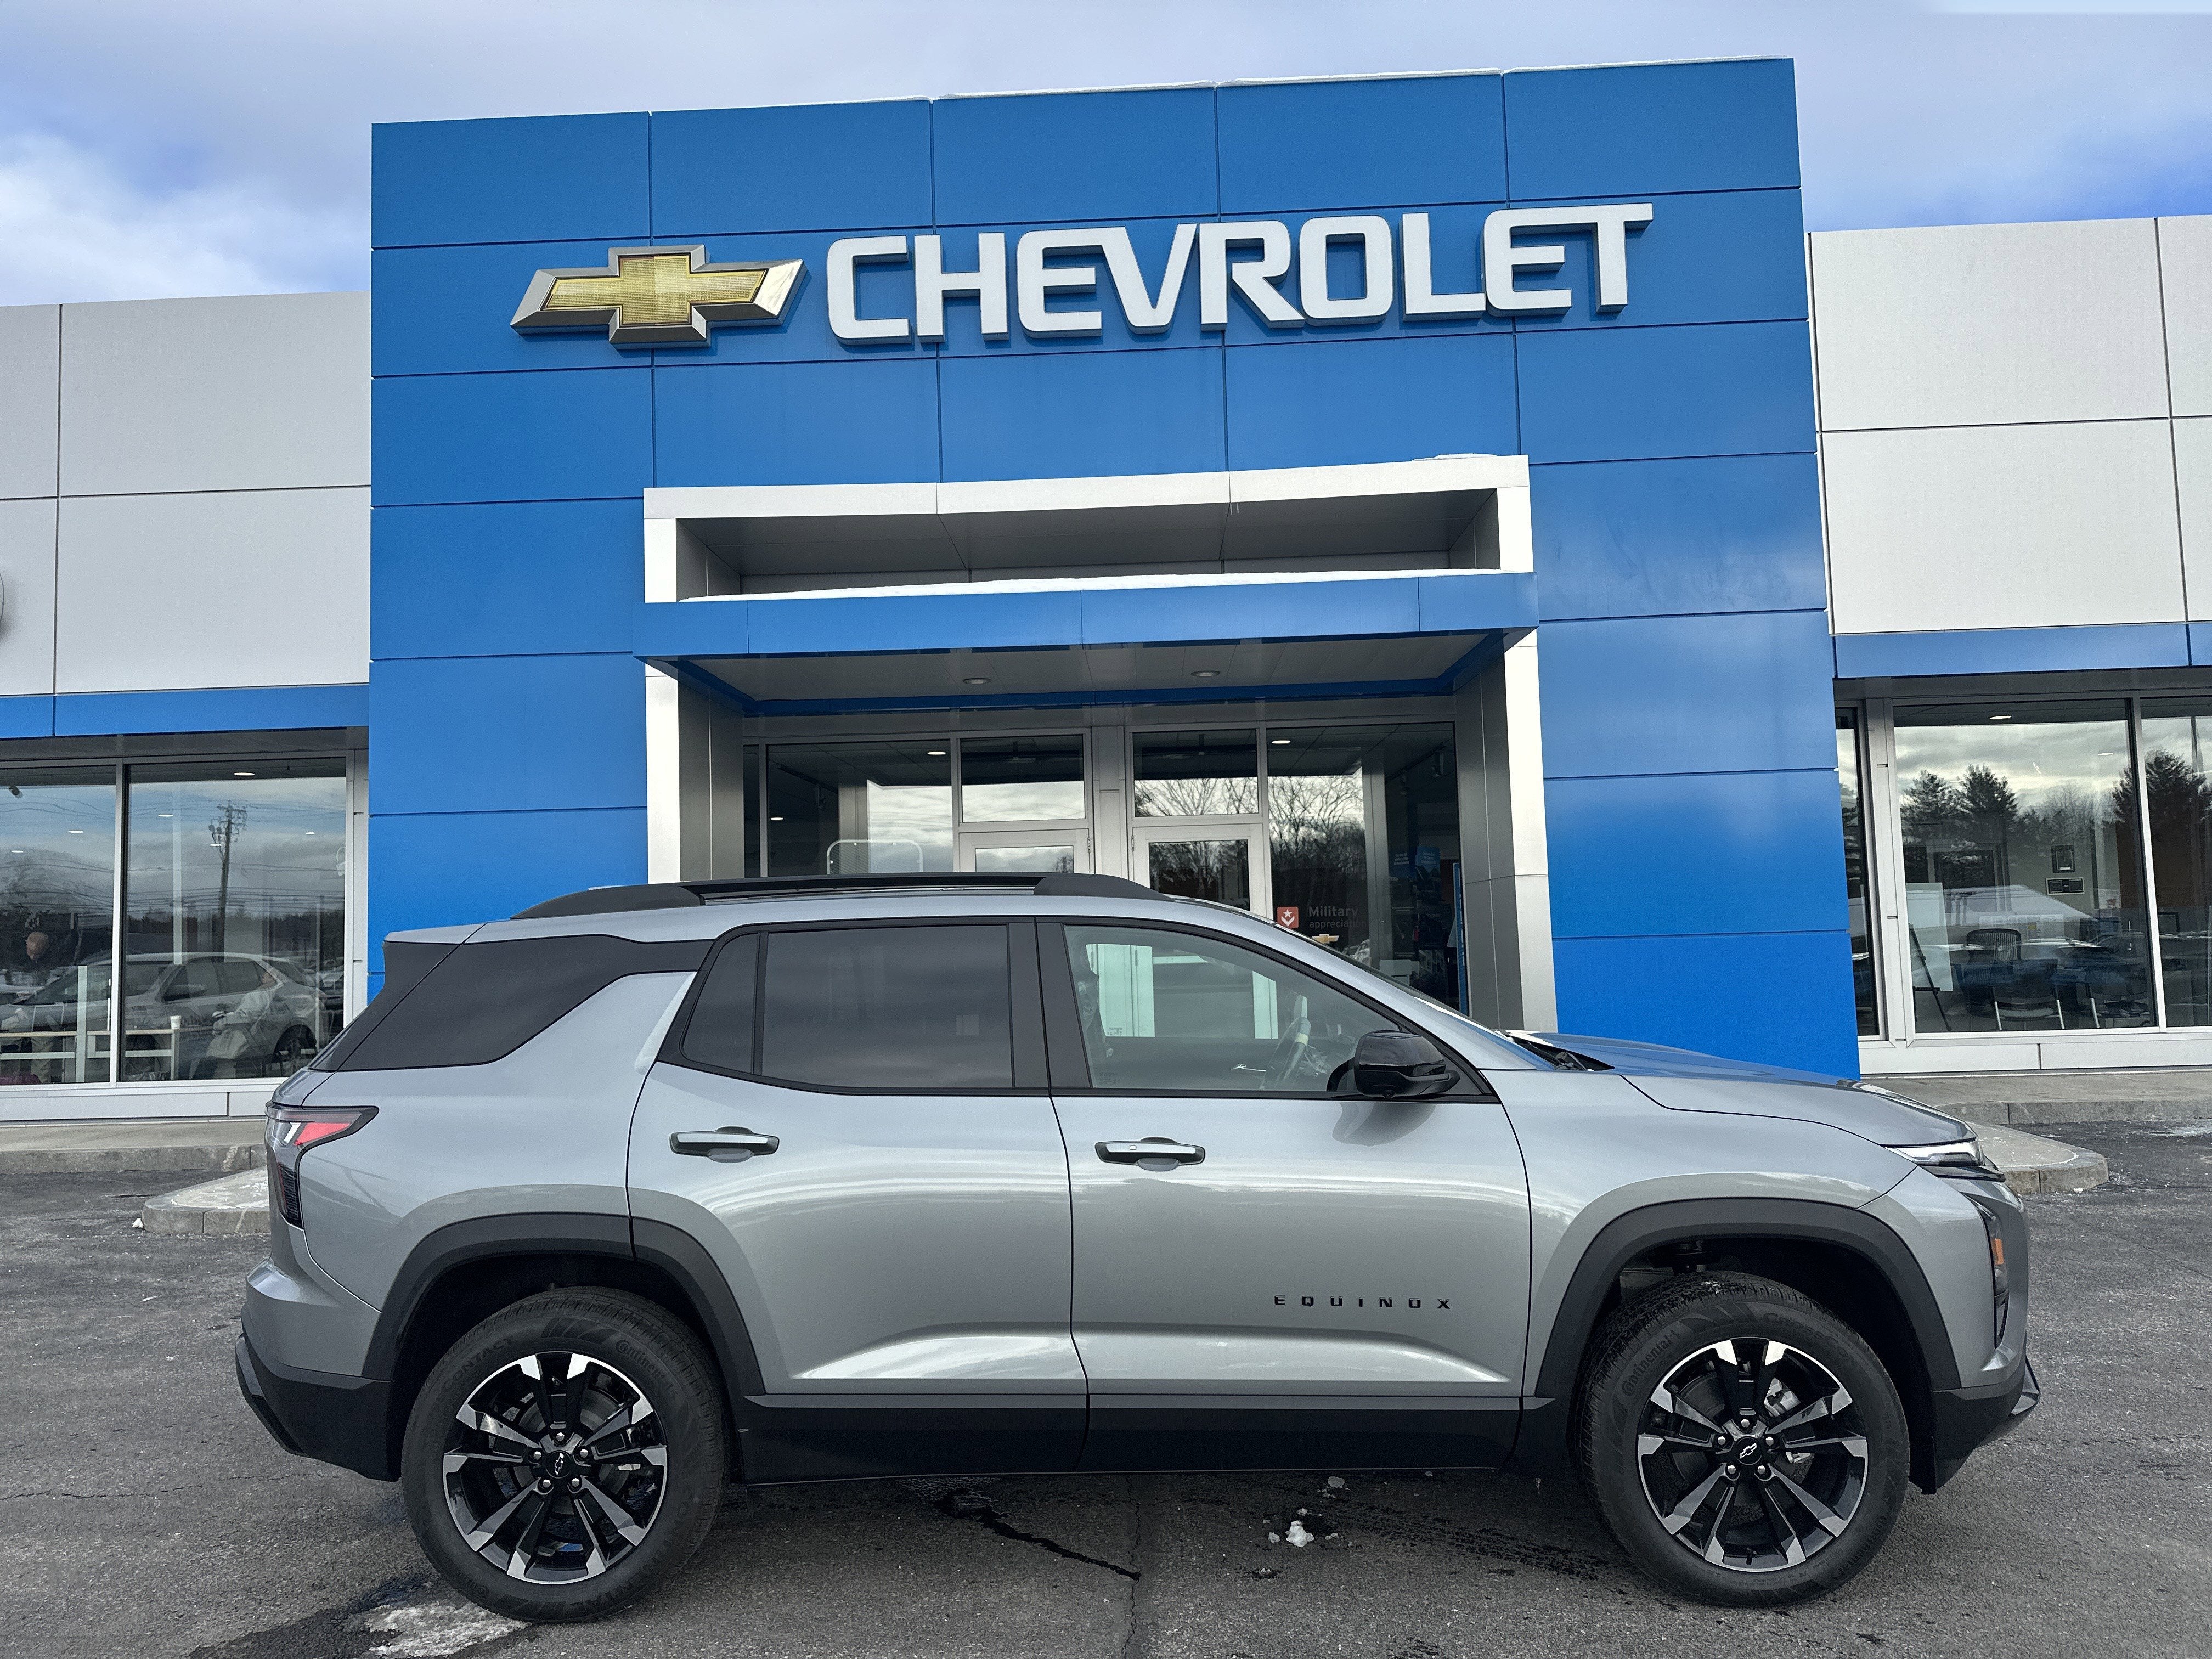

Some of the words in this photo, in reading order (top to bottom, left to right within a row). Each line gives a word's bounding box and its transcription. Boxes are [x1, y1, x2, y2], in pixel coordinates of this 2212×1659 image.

[826, 203, 1654, 345] CHEVROLET
[1308, 906, 1359, 918] Military
[1309, 919, 1368, 930] appreciation
[1274, 1295, 1451, 1310] EQUINOX
[1622, 1335, 1674, 1396] Continental
